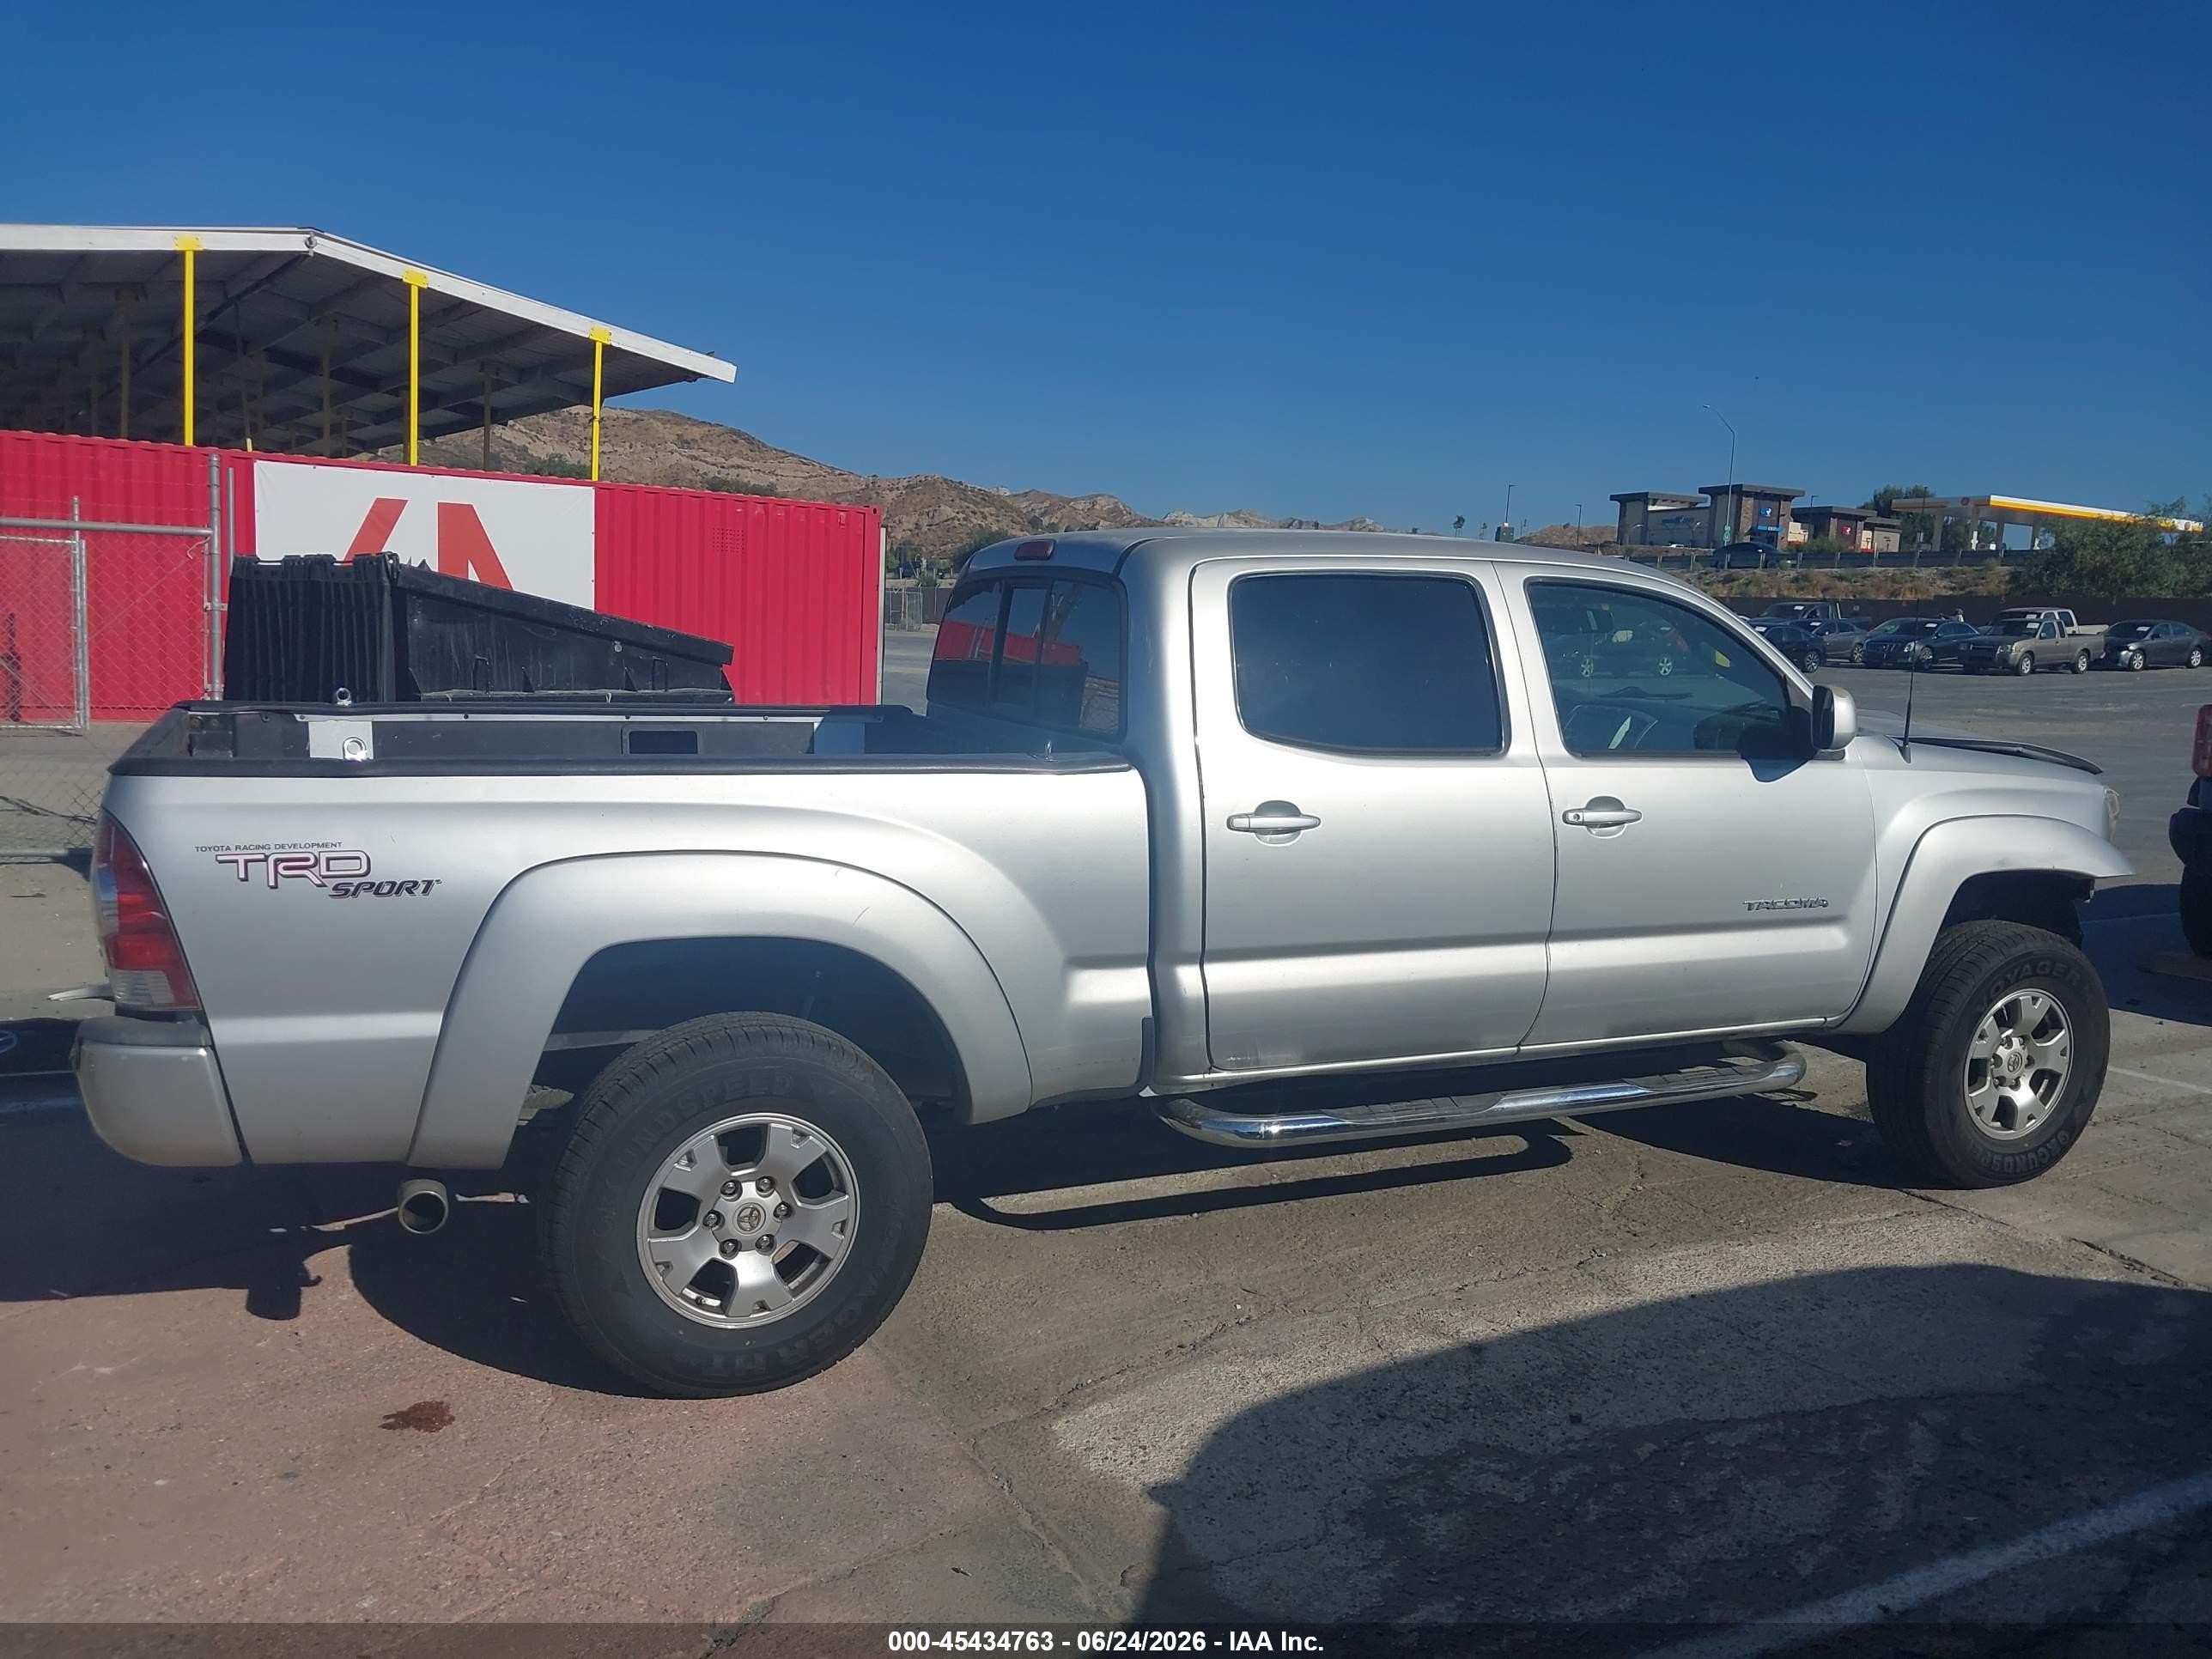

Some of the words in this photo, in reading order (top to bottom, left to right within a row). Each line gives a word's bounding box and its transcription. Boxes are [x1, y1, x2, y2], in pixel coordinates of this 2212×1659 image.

[274, 842, 343, 850] DEVELOPMENT
[216, 850, 372, 889] TRD
[328, 879, 439, 899] SPORT
[1742, 897, 1830, 911] TACOMA
